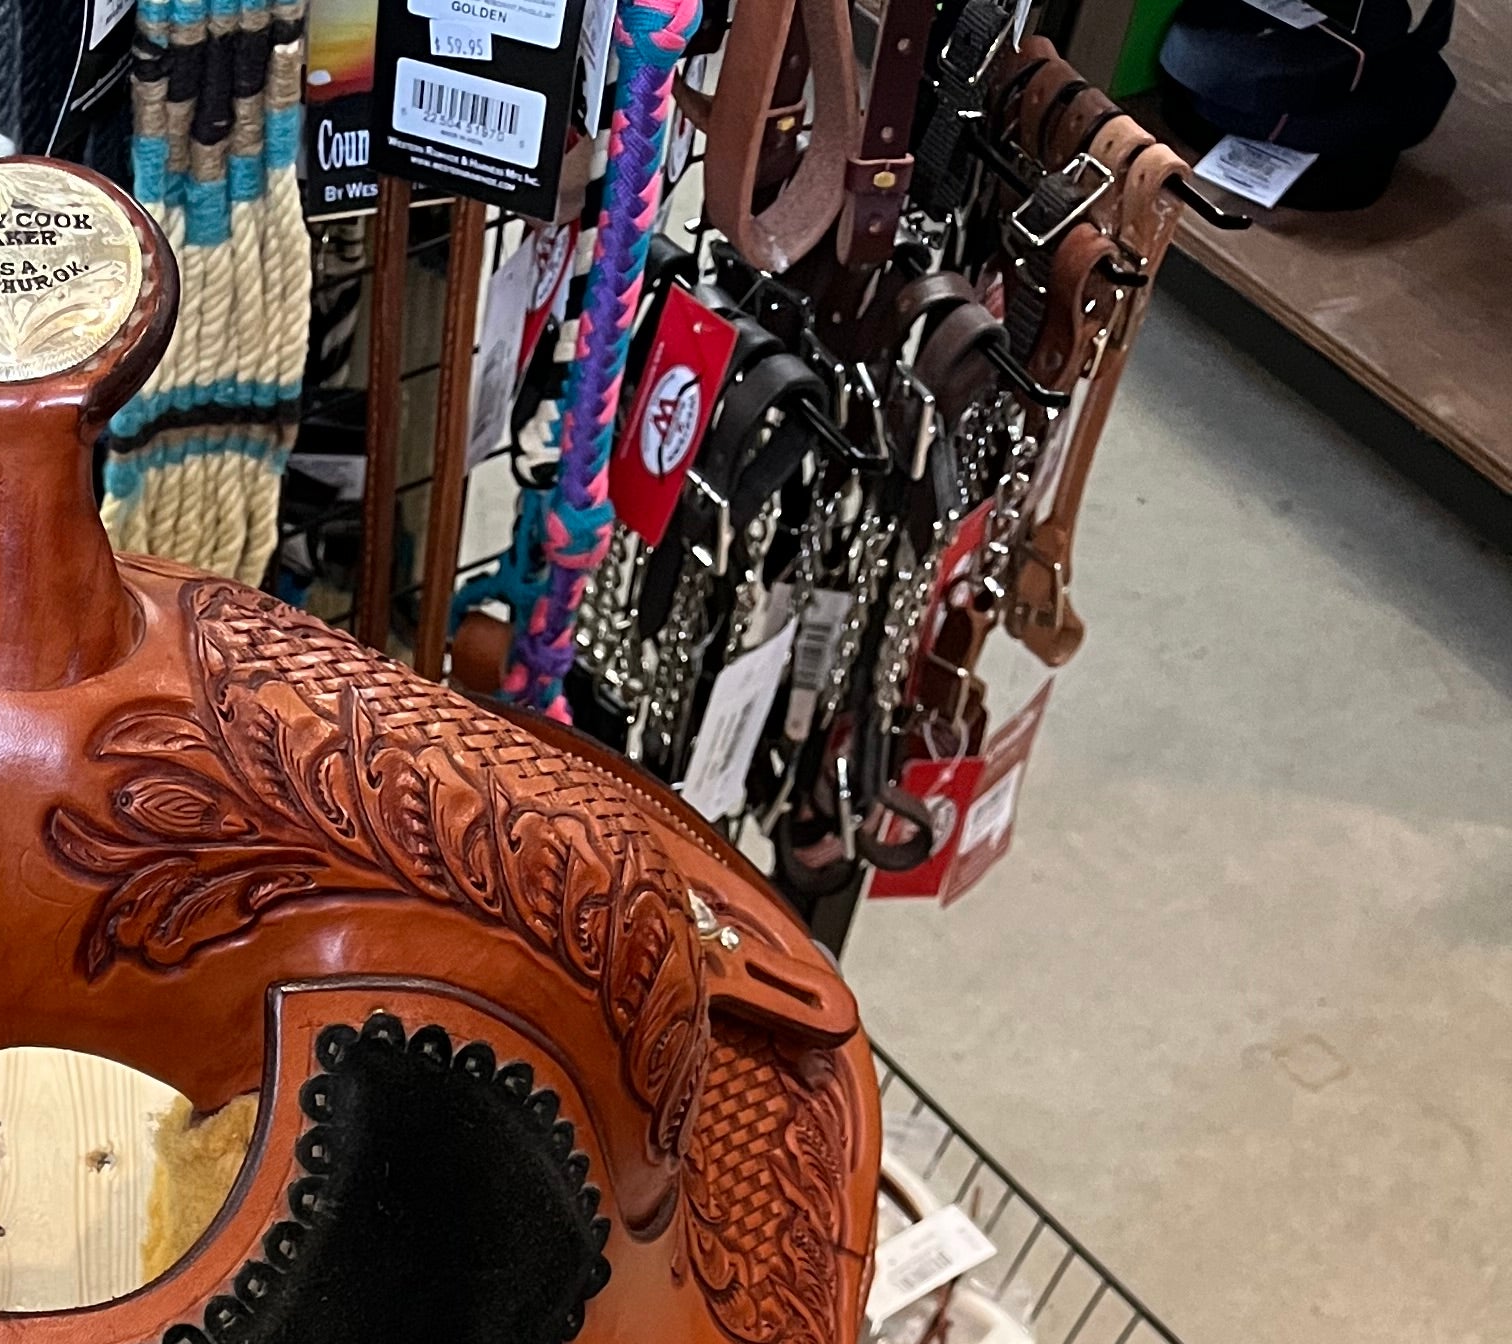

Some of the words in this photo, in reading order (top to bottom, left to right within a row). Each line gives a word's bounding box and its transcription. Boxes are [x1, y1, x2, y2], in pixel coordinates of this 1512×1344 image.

[451, 1, 508, 23] GOLDEN
[447, 35, 483, 56] 59.95
[16, 212, 93, 230] COOK
